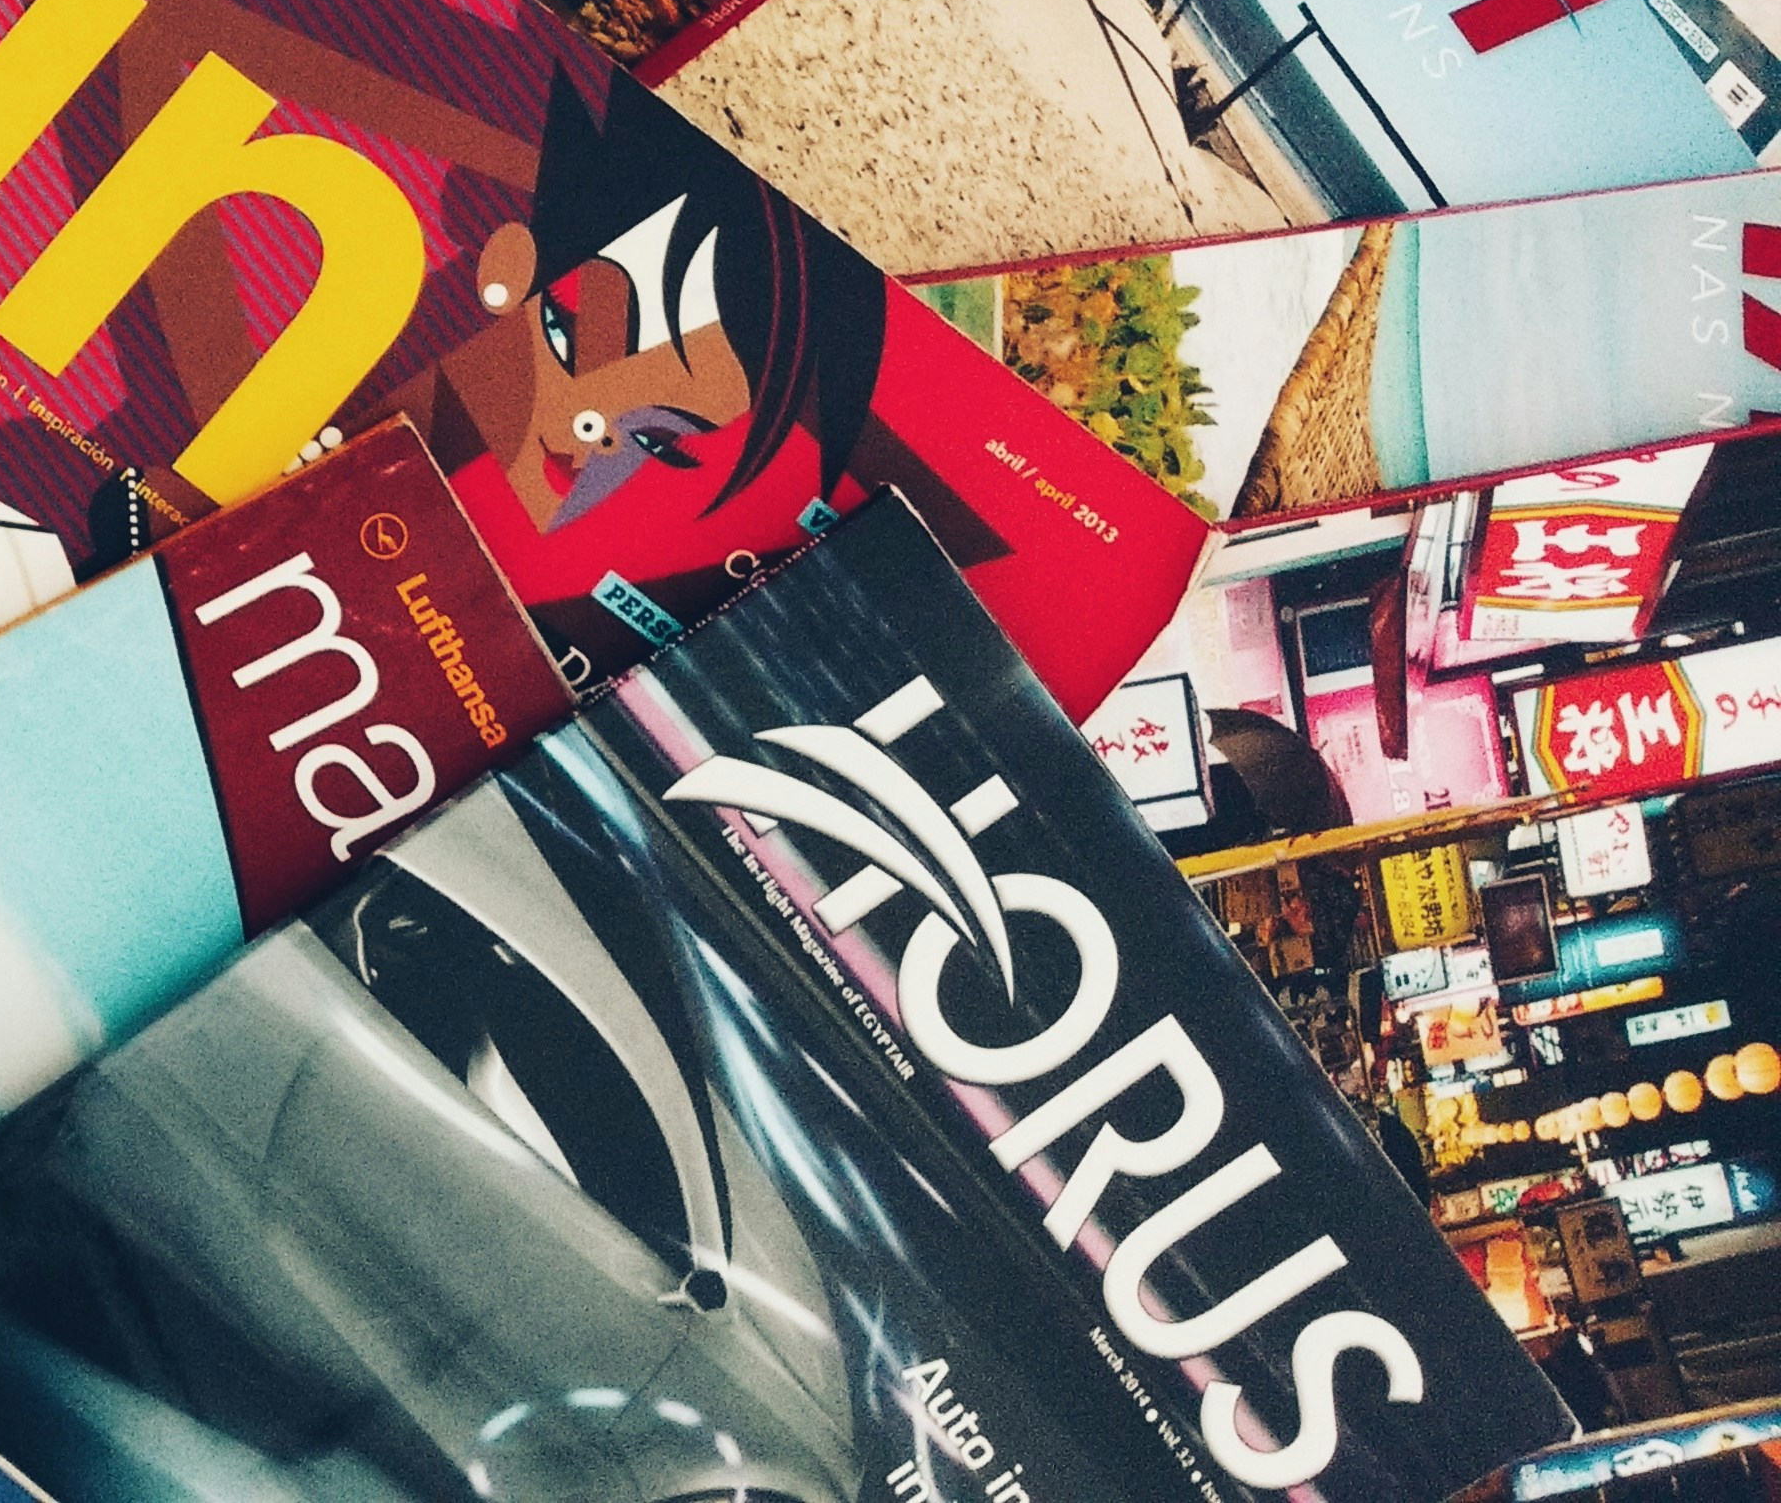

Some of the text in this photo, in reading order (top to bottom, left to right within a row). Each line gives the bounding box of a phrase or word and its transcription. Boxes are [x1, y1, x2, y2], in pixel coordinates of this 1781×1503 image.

[1692, 214, 1729, 346] NAS
[28, 396, 114, 471] inspiración
[984, 437, 1120, 546] abril april 2013
[394, 572, 508, 750] Lufthansa
[788, 913, 915, 1082] Magazine EGYPTAIR
[663, 674, 1424, 1490] HORUS
[902, 1358, 994, 1471] Auto
